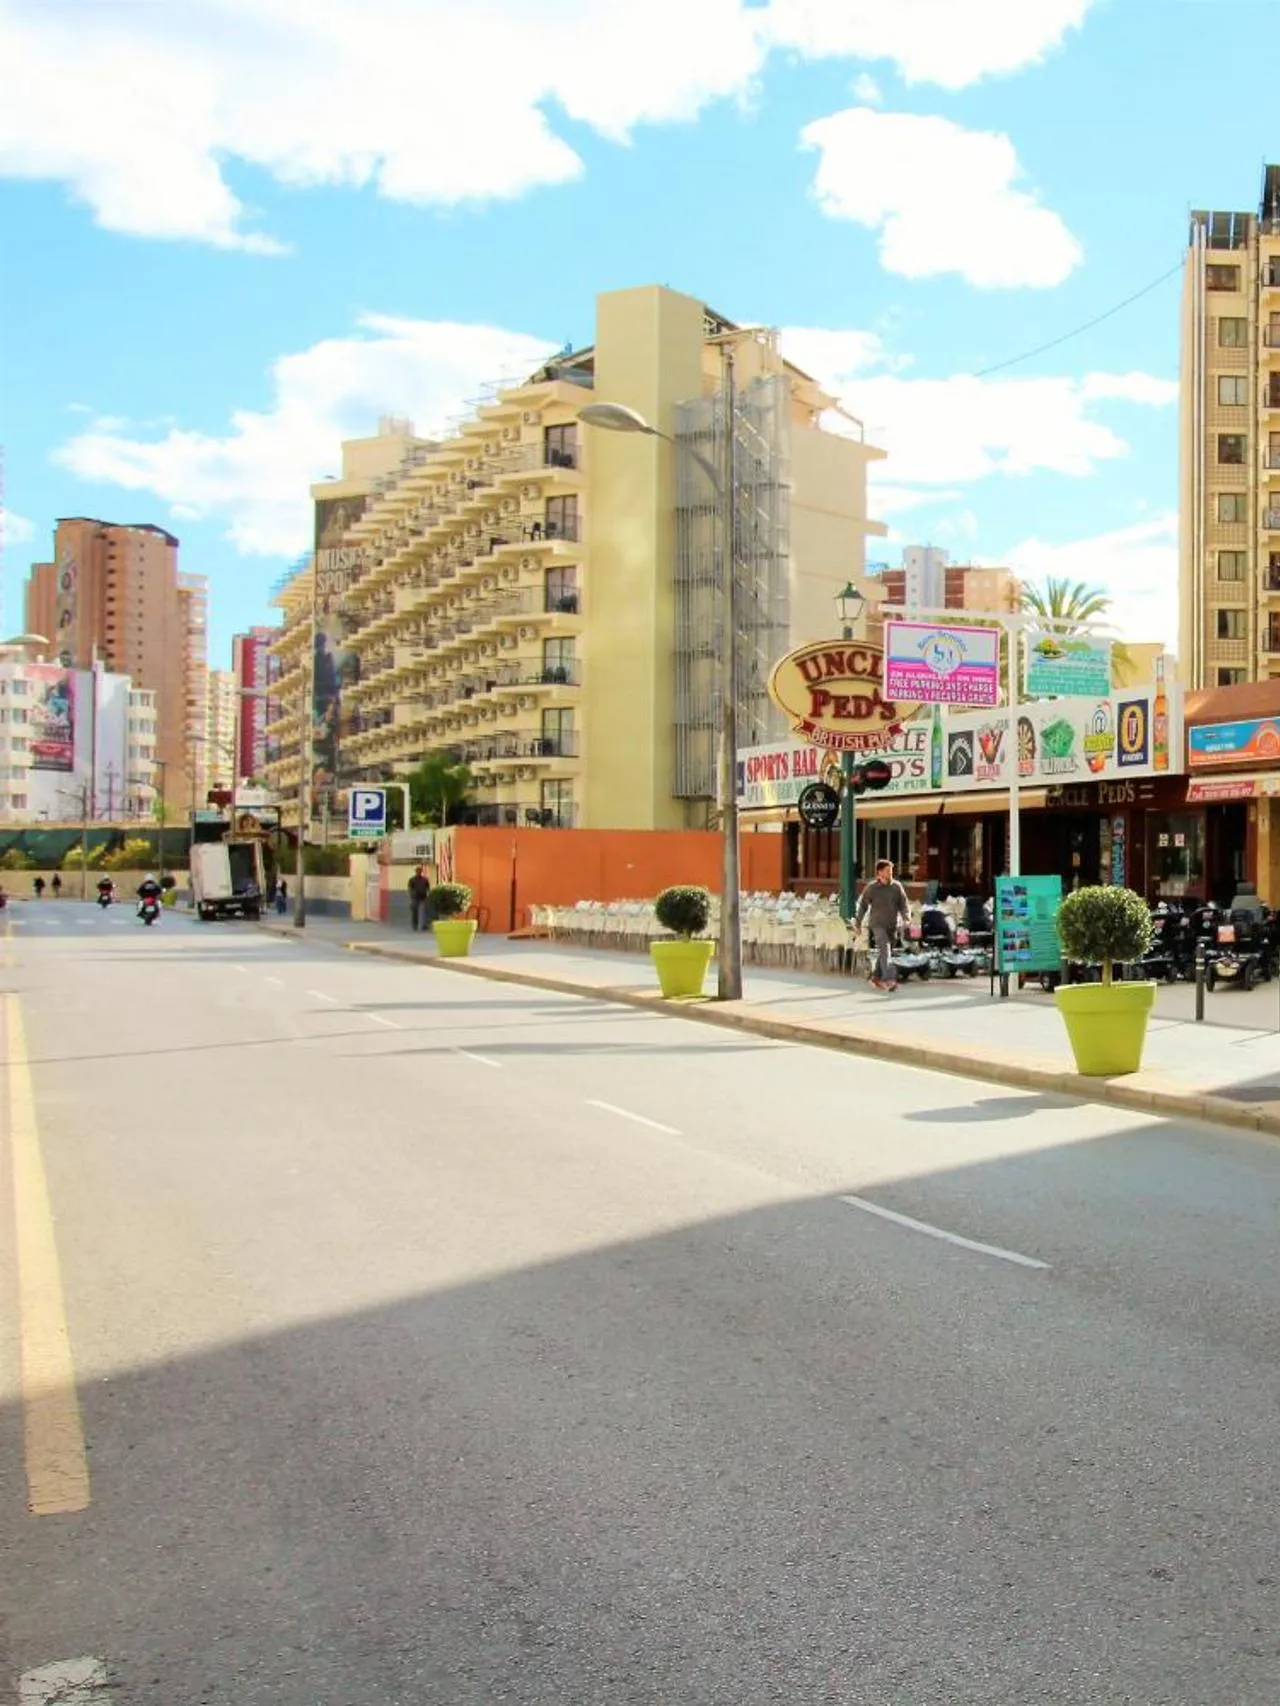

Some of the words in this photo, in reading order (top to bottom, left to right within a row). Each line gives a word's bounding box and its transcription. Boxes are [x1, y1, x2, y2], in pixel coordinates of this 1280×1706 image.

[796, 651, 883, 683] UNCL
[809, 687, 897, 720] PED'S
[811, 728, 864, 750] BRITISH
[747, 752, 789, 783] SPORTS
[792, 749, 818, 776] BAR
[355, 793, 380, 819] P
[1098, 780, 1135, 804] PED'S
